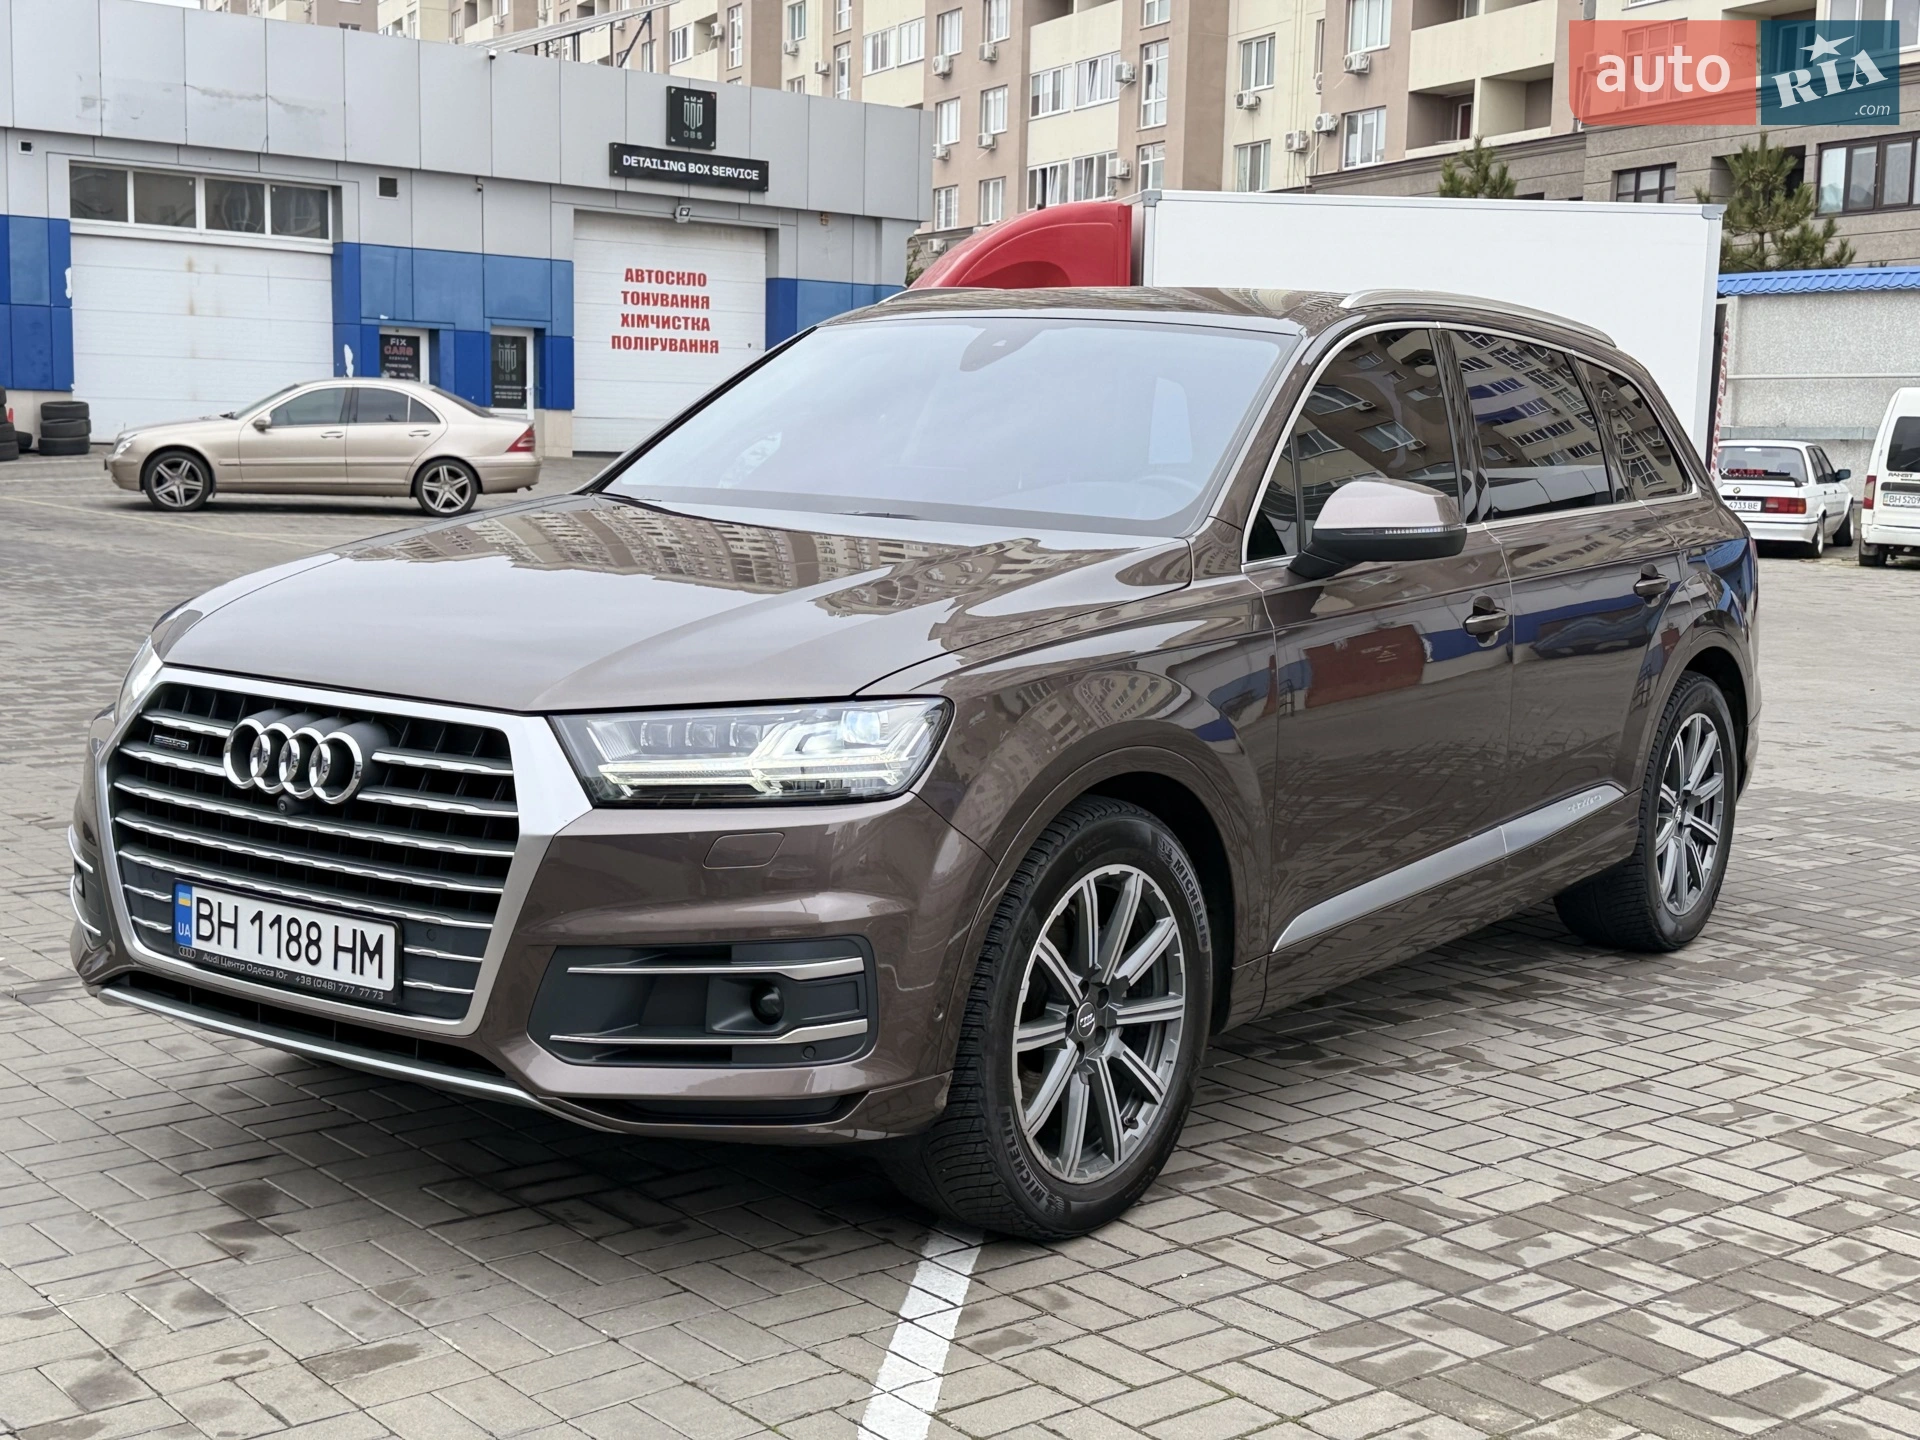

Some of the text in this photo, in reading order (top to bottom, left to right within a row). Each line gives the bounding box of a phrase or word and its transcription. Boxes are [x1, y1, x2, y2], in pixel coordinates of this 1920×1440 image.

[622, 155, 760, 181] DETAILING BOX SERVICE
[624, 268, 707, 287] АВТОСКЛО
[620, 290, 710, 310] ТОНУВАННЯ
[620, 313, 711, 332] ХІМЧИСТКА
[390, 337, 407, 346] FIX
[611, 335, 719, 354] ПОЛІРУВАННЯ
[1173, 859, 1209, 947] MICHELIN
[178, 922, 191, 938] UA
[195, 896, 384, 980] BH 1188 HM
[202, 953, 289, 980] Audi Центр Одесса Юг
[295, 975, 312, 986] +38
[338, 984, 355, 995] 777
[1000, 1110, 1047, 1204] MICHELIN
